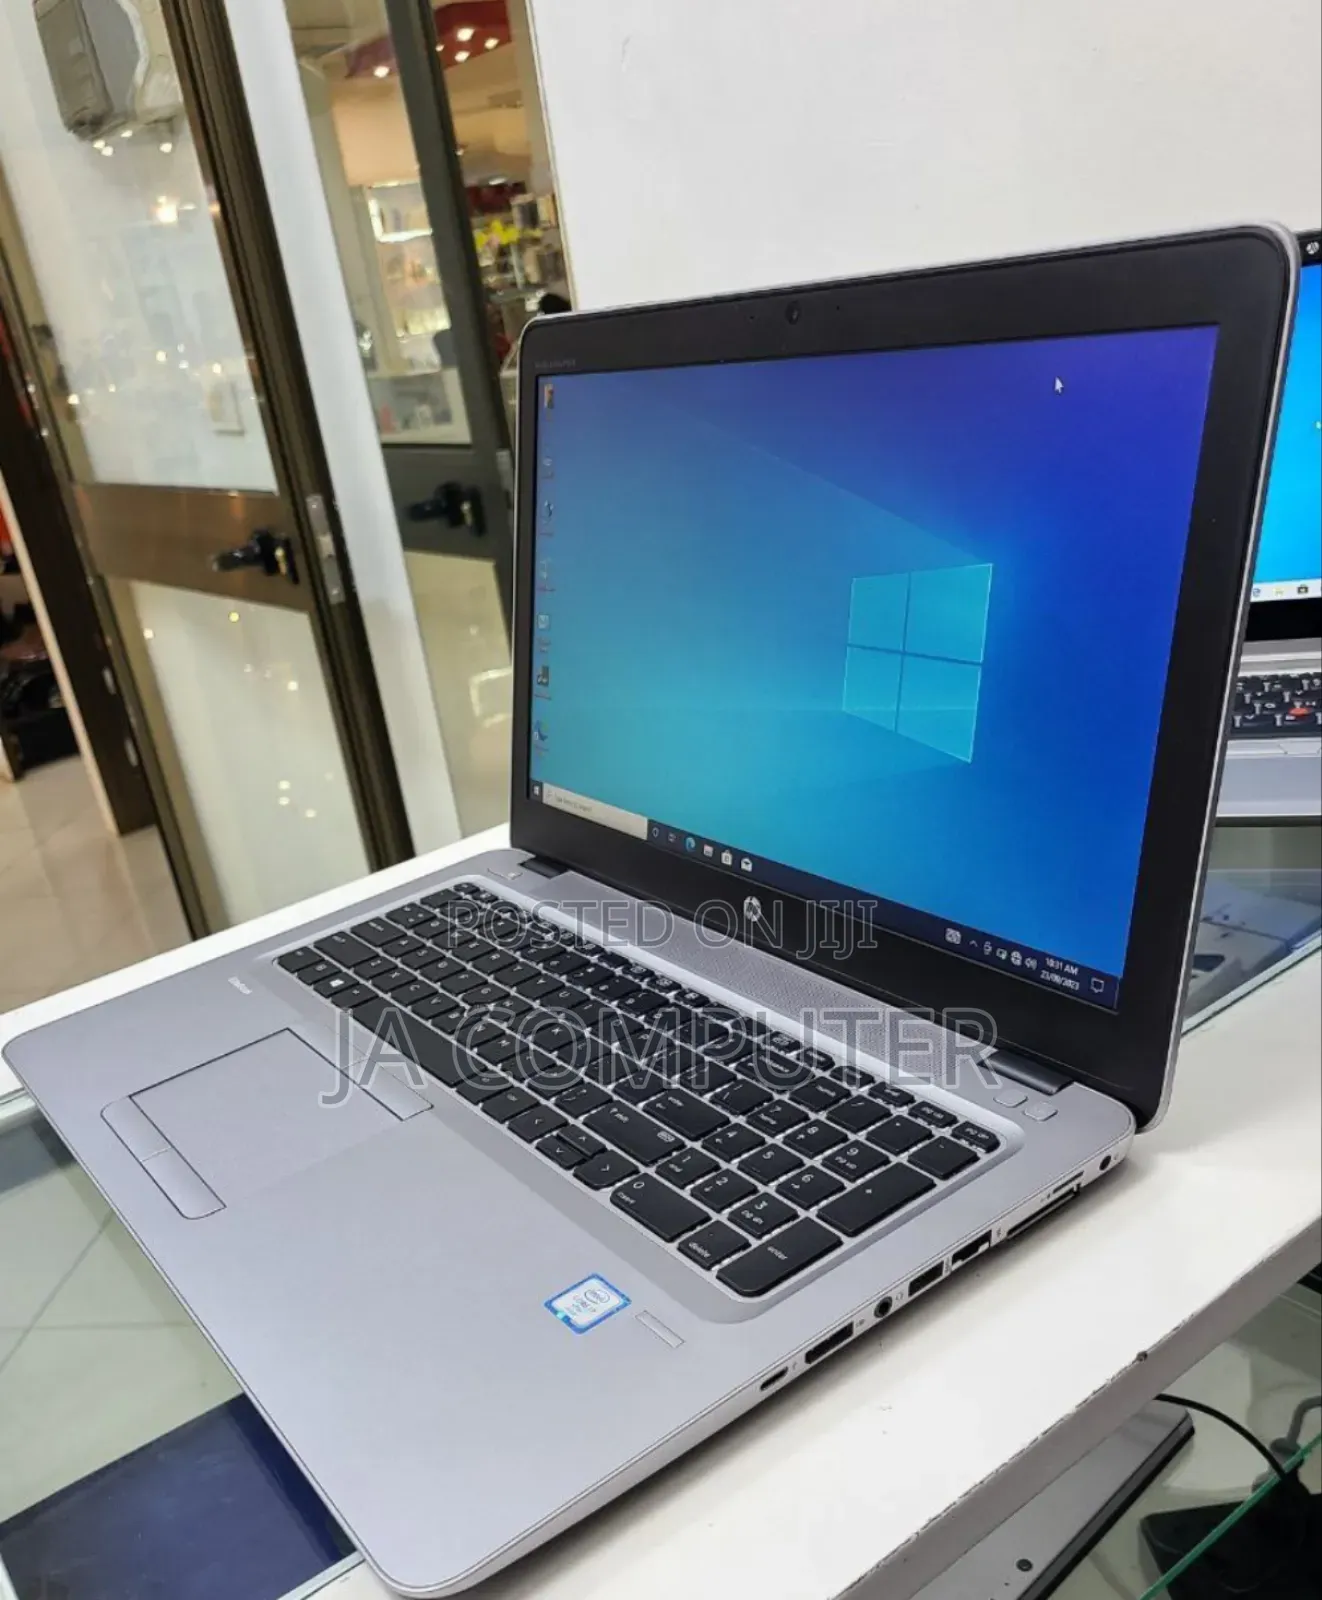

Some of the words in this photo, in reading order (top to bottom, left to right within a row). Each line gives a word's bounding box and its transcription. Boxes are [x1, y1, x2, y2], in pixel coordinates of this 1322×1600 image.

[1064, 963, 1079, 976] AM
[807, 1125, 820, 1135] 8
[762, 1150, 774, 1160] 5
[846, 1146, 859, 1157] 9
[715, 1176, 729, 1187] 2
[801, 1173, 815, 1184] 6
[632, 1180, 645, 1190] 0
[753, 1200, 768, 1210] 3
[687, 1241, 712, 1259] delete
[766, 1245, 789, 1262] enter
